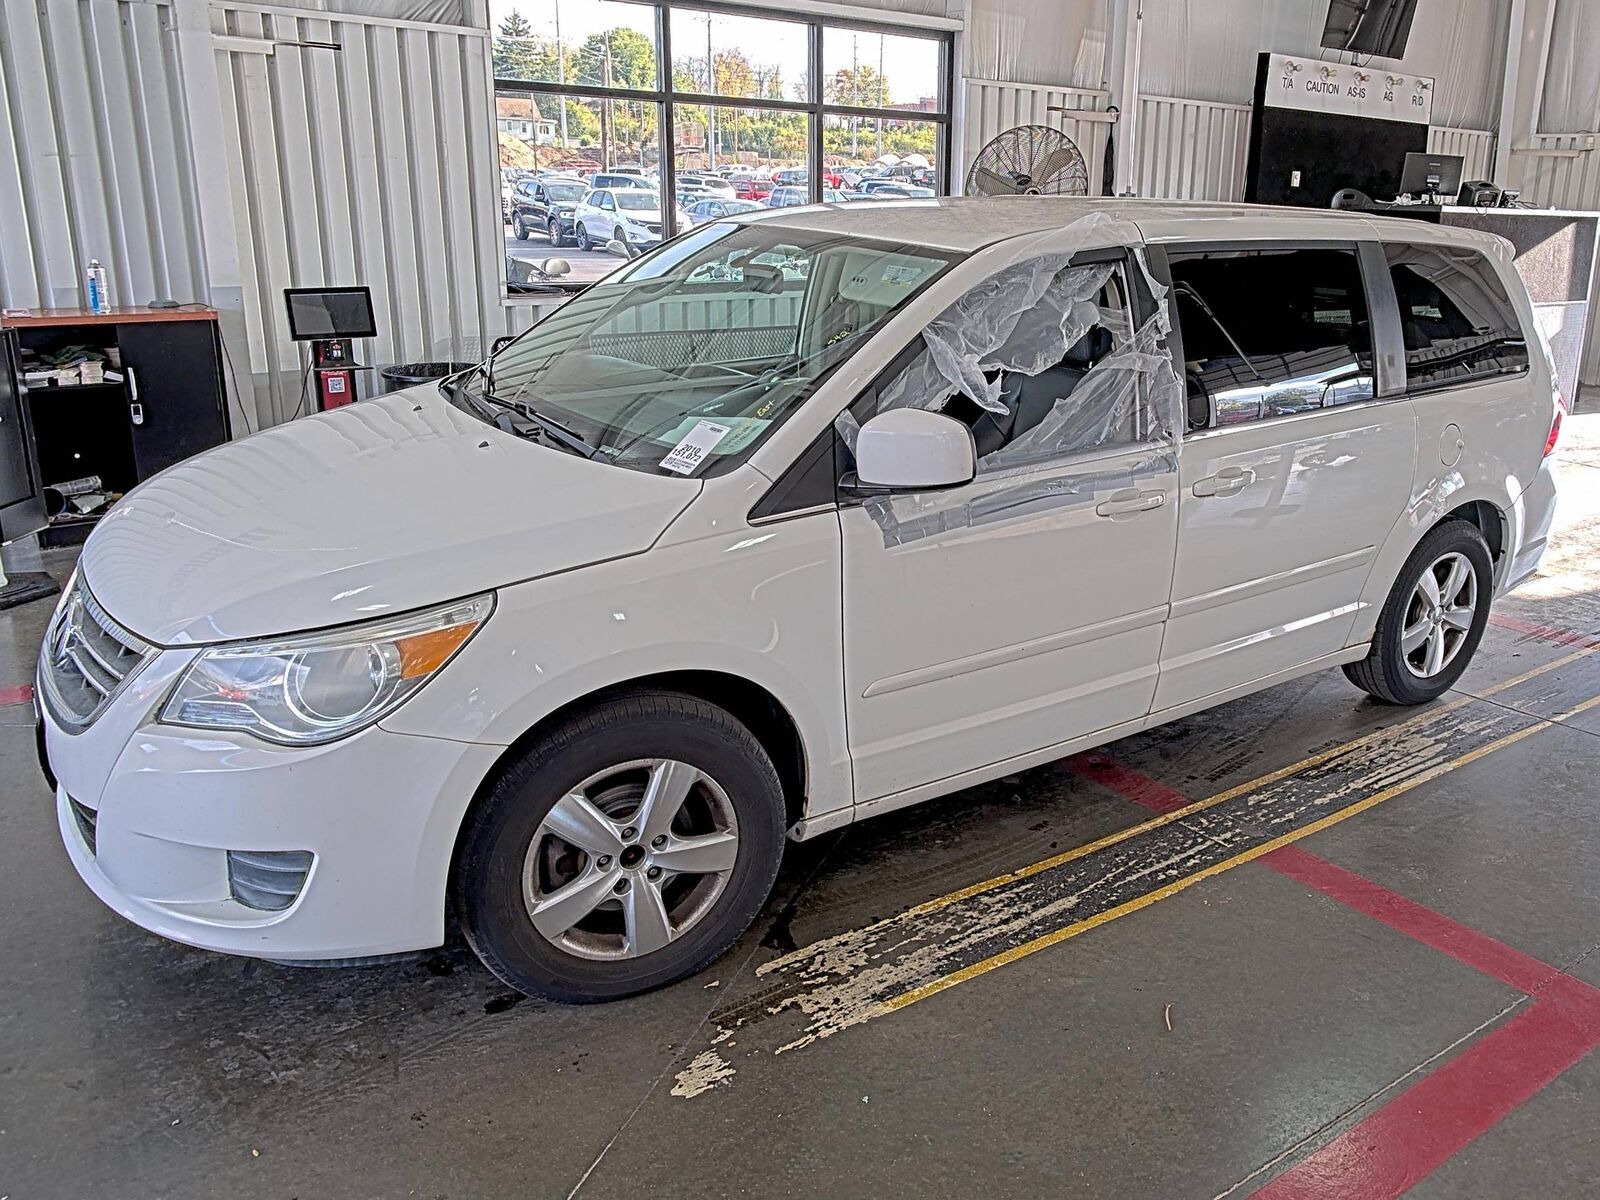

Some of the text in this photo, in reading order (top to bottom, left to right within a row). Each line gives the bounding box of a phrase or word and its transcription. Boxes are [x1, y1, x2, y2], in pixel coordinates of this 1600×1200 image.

[1306, 80, 1340, 95] CAUTION
[1347, 86, 1366, 99] AS-IS
[1383, 91, 1393, 102] AG
[671, 448, 702, 462] 151,072
[681, 444, 702, 455] 2010
